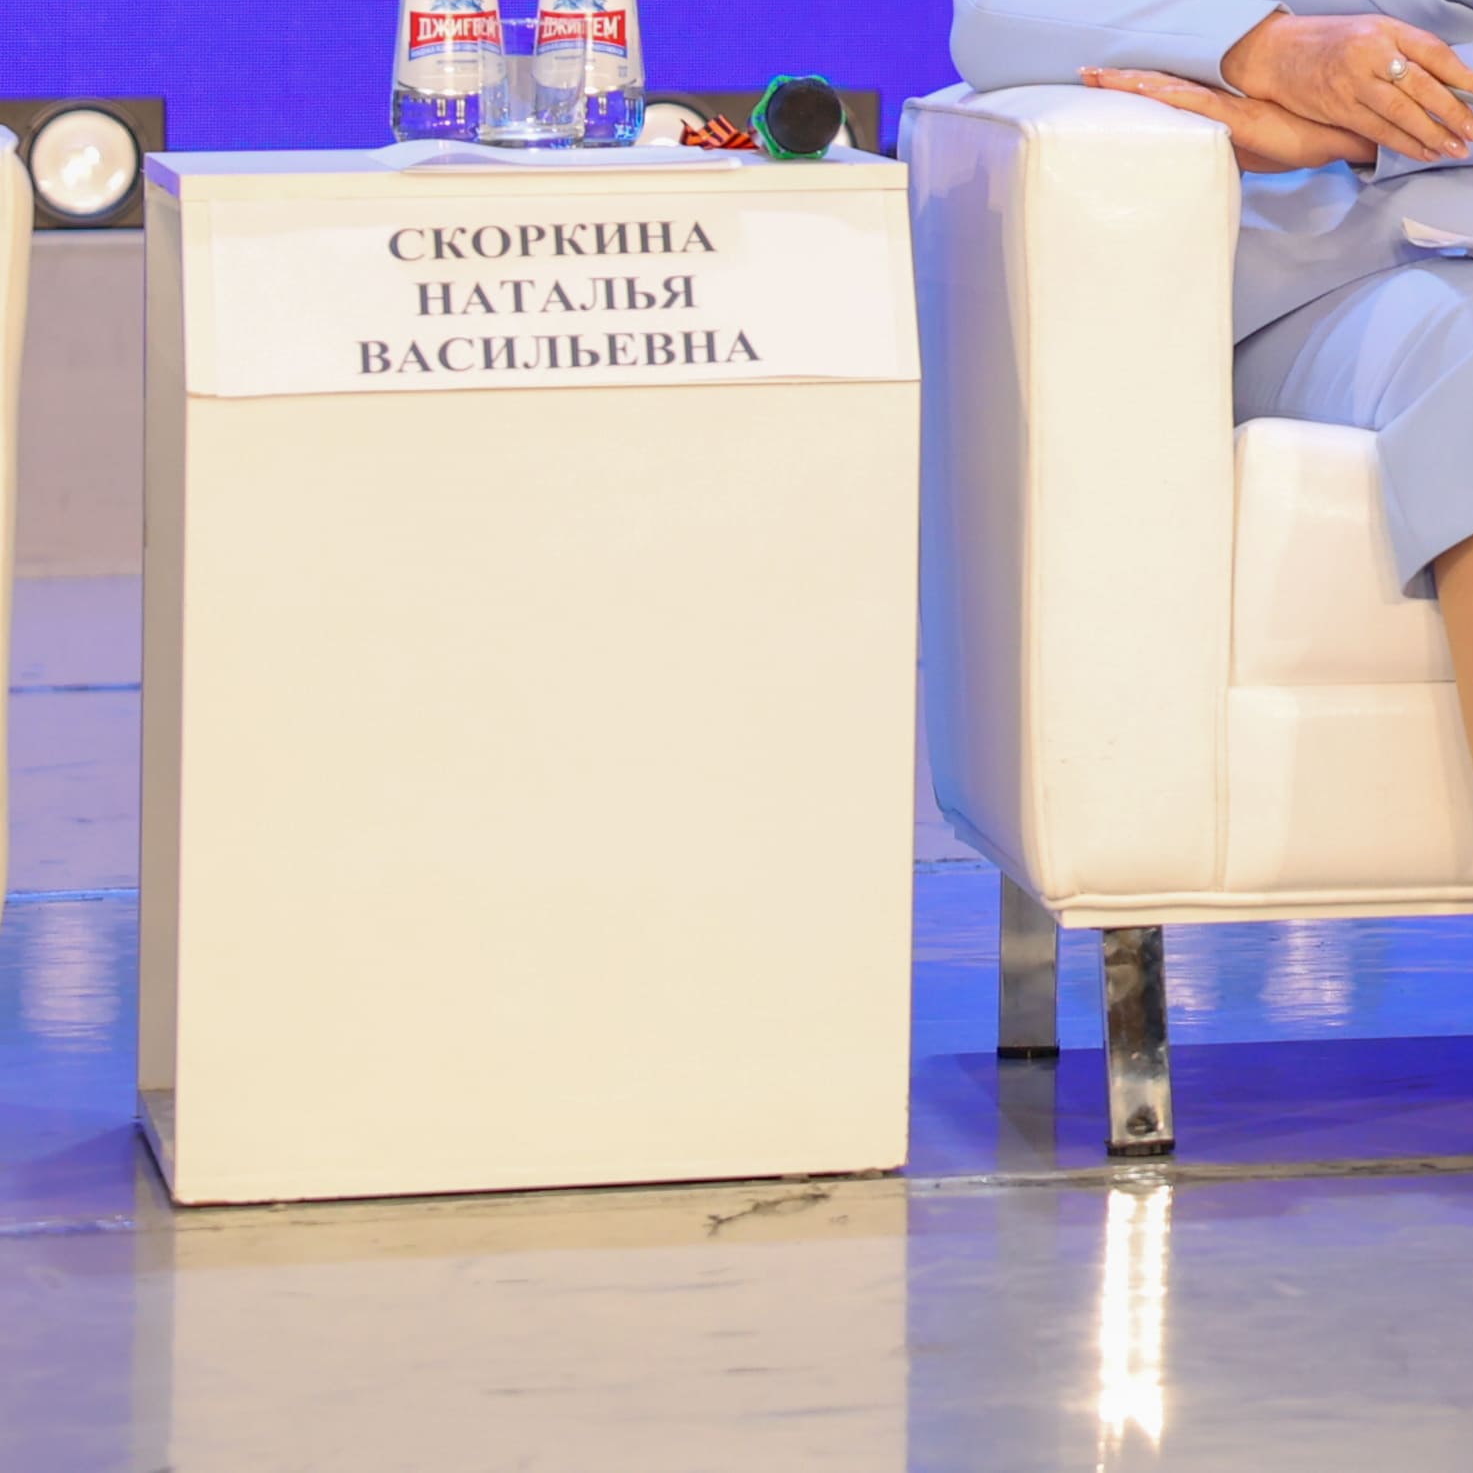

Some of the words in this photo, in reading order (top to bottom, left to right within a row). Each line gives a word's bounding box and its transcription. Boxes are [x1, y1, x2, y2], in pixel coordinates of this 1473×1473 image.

[387, 220, 717, 262] СКОРКИНА
[416, 275, 699, 317] НАТАЛЬЯ
[357, 330, 763, 376] ВАСИЛЬЕВНА
